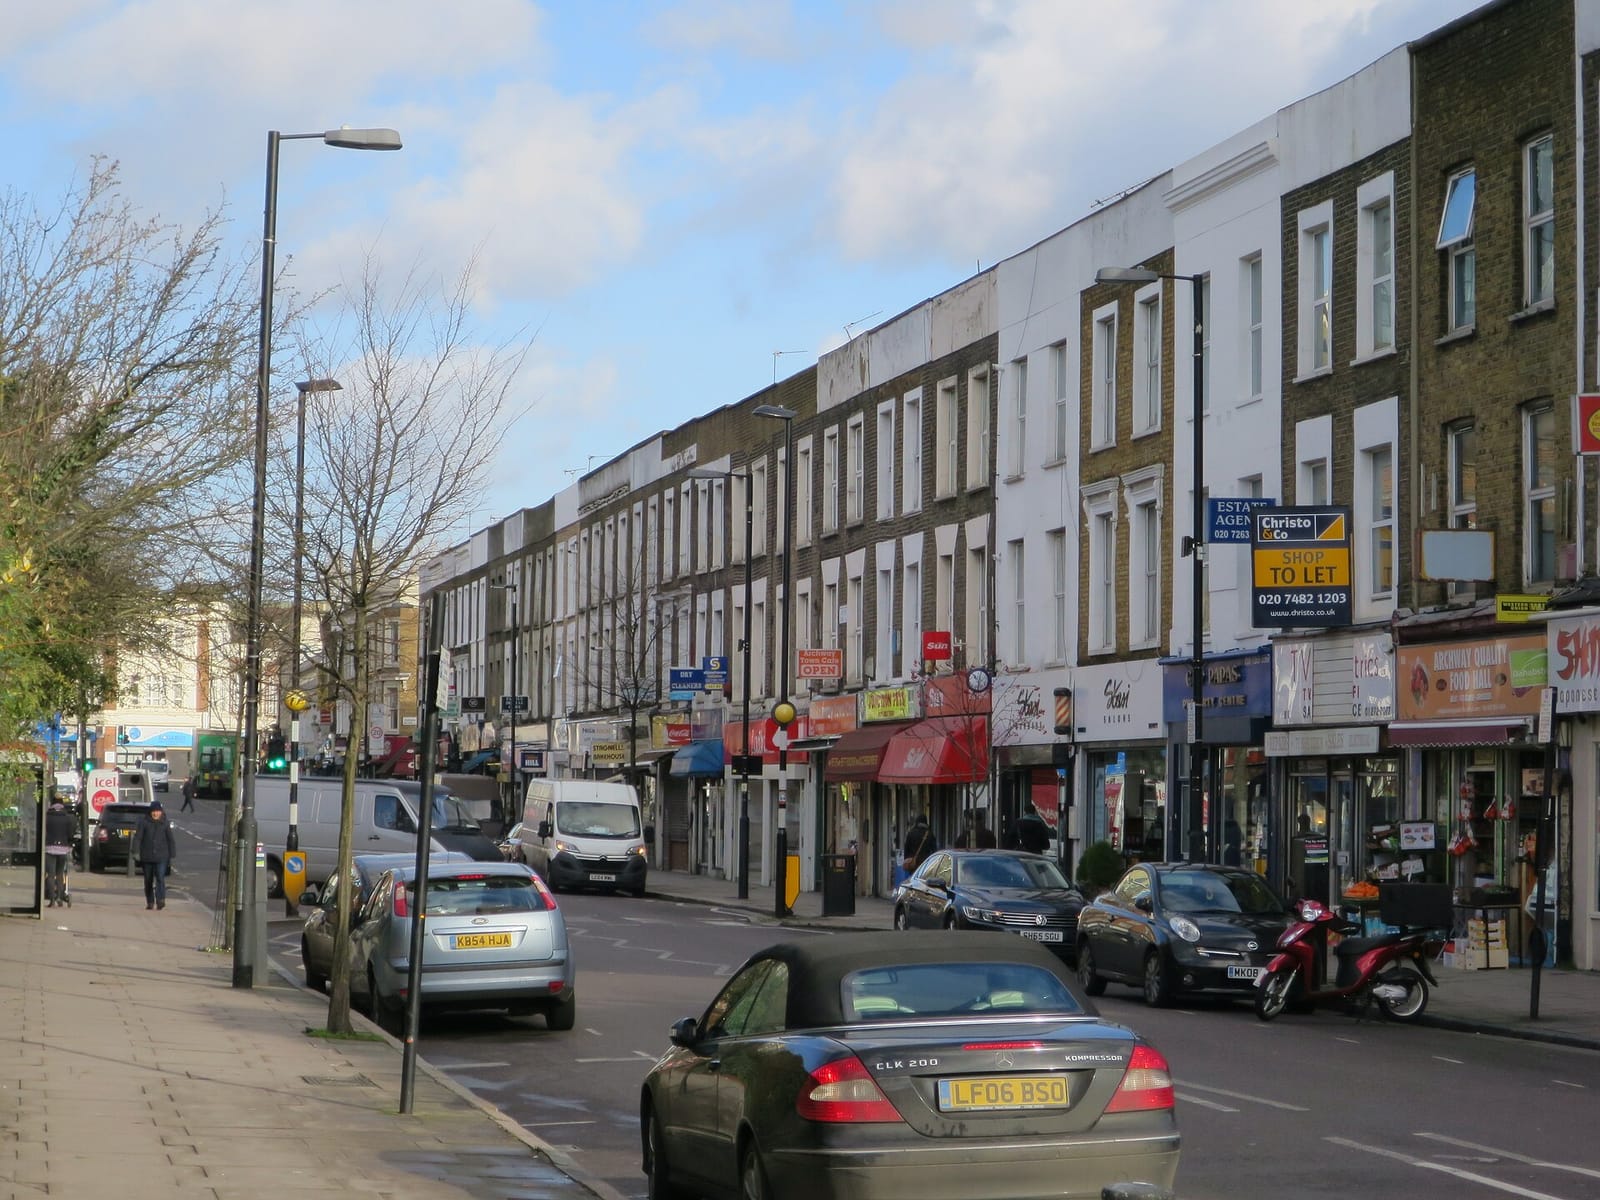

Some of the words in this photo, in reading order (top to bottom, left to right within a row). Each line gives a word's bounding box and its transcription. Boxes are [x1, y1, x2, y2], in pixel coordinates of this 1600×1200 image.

[1216, 515, 1251, 526] AGEN
[1262, 517, 1311, 531] Christo
[1214, 530, 1229, 539] 020
[1282, 551, 1324, 567] SHOP
[1270, 567, 1296, 585] TO
[1303, 566, 1337, 584] LET
[1258, 594, 1281, 605] 020
[1284, 594, 1314, 604] 7482
[1317, 593, 1347, 604] 1203
[1270, 608, 1336, 618] www.christo.co.uk
[1434, 649, 1472, 670] ARCHWAY
[1474, 644, 1508, 666] QUALITY
[680, 671, 693, 679] DRY
[803, 666, 837, 675] OPEN
[1450, 671, 1470, 690] FOOD
[1472, 668, 1492, 688] HALL
[457, 935, 485, 947] KB54
[488, 934, 510, 945] HJA
[875, 1062, 904, 1071] CLK
[908, 1058, 939, 1068] 200
[1064, 1054, 1124, 1063] KOMPRESSOR
[954, 1082, 1016, 1105] LF06
